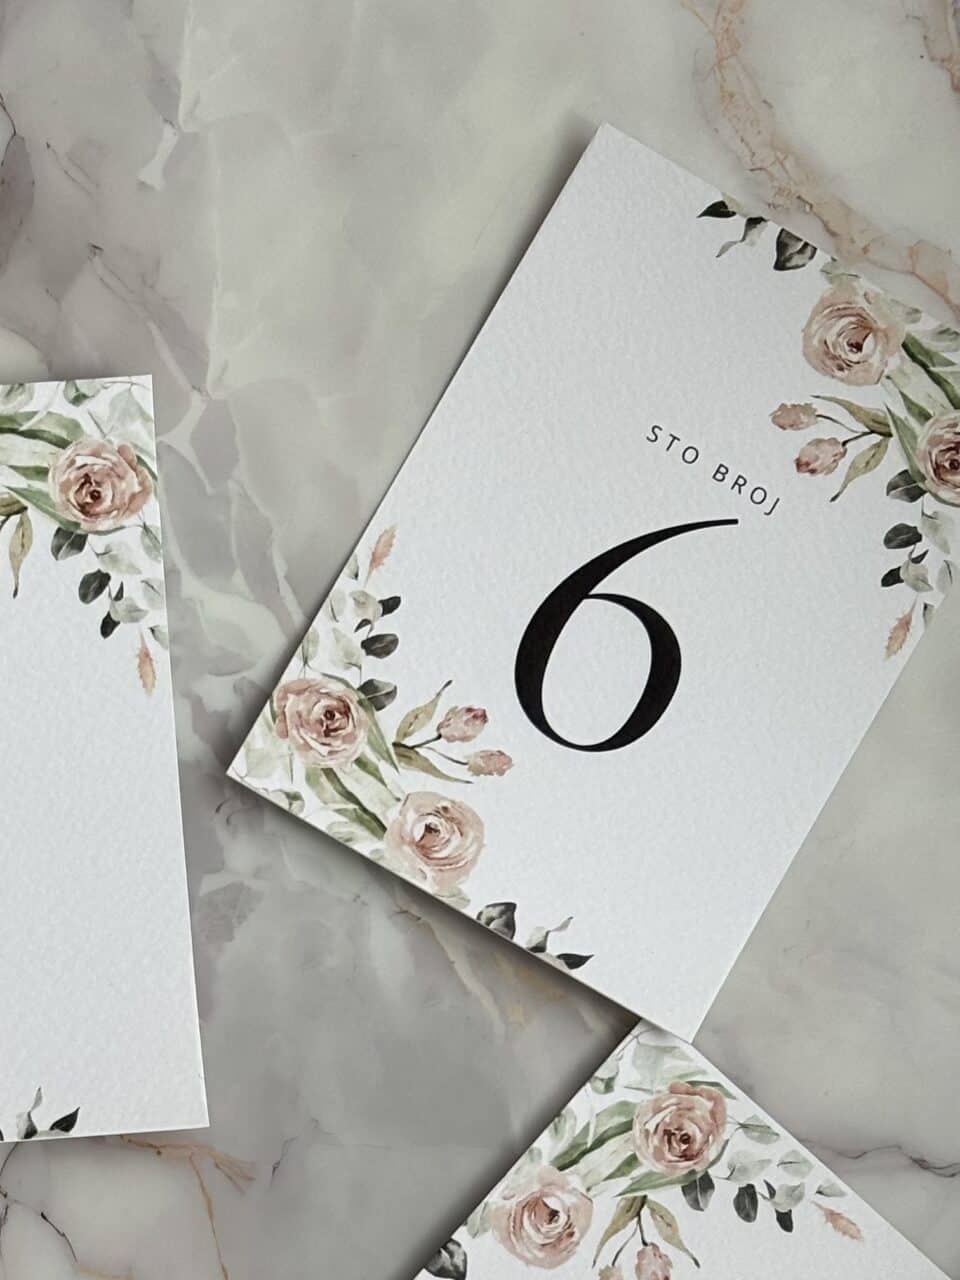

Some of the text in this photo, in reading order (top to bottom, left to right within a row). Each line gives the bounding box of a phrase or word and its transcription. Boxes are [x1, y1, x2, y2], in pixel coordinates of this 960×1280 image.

[646, 424, 780, 517] STO BROJ
[514, 518, 739, 753] 6
